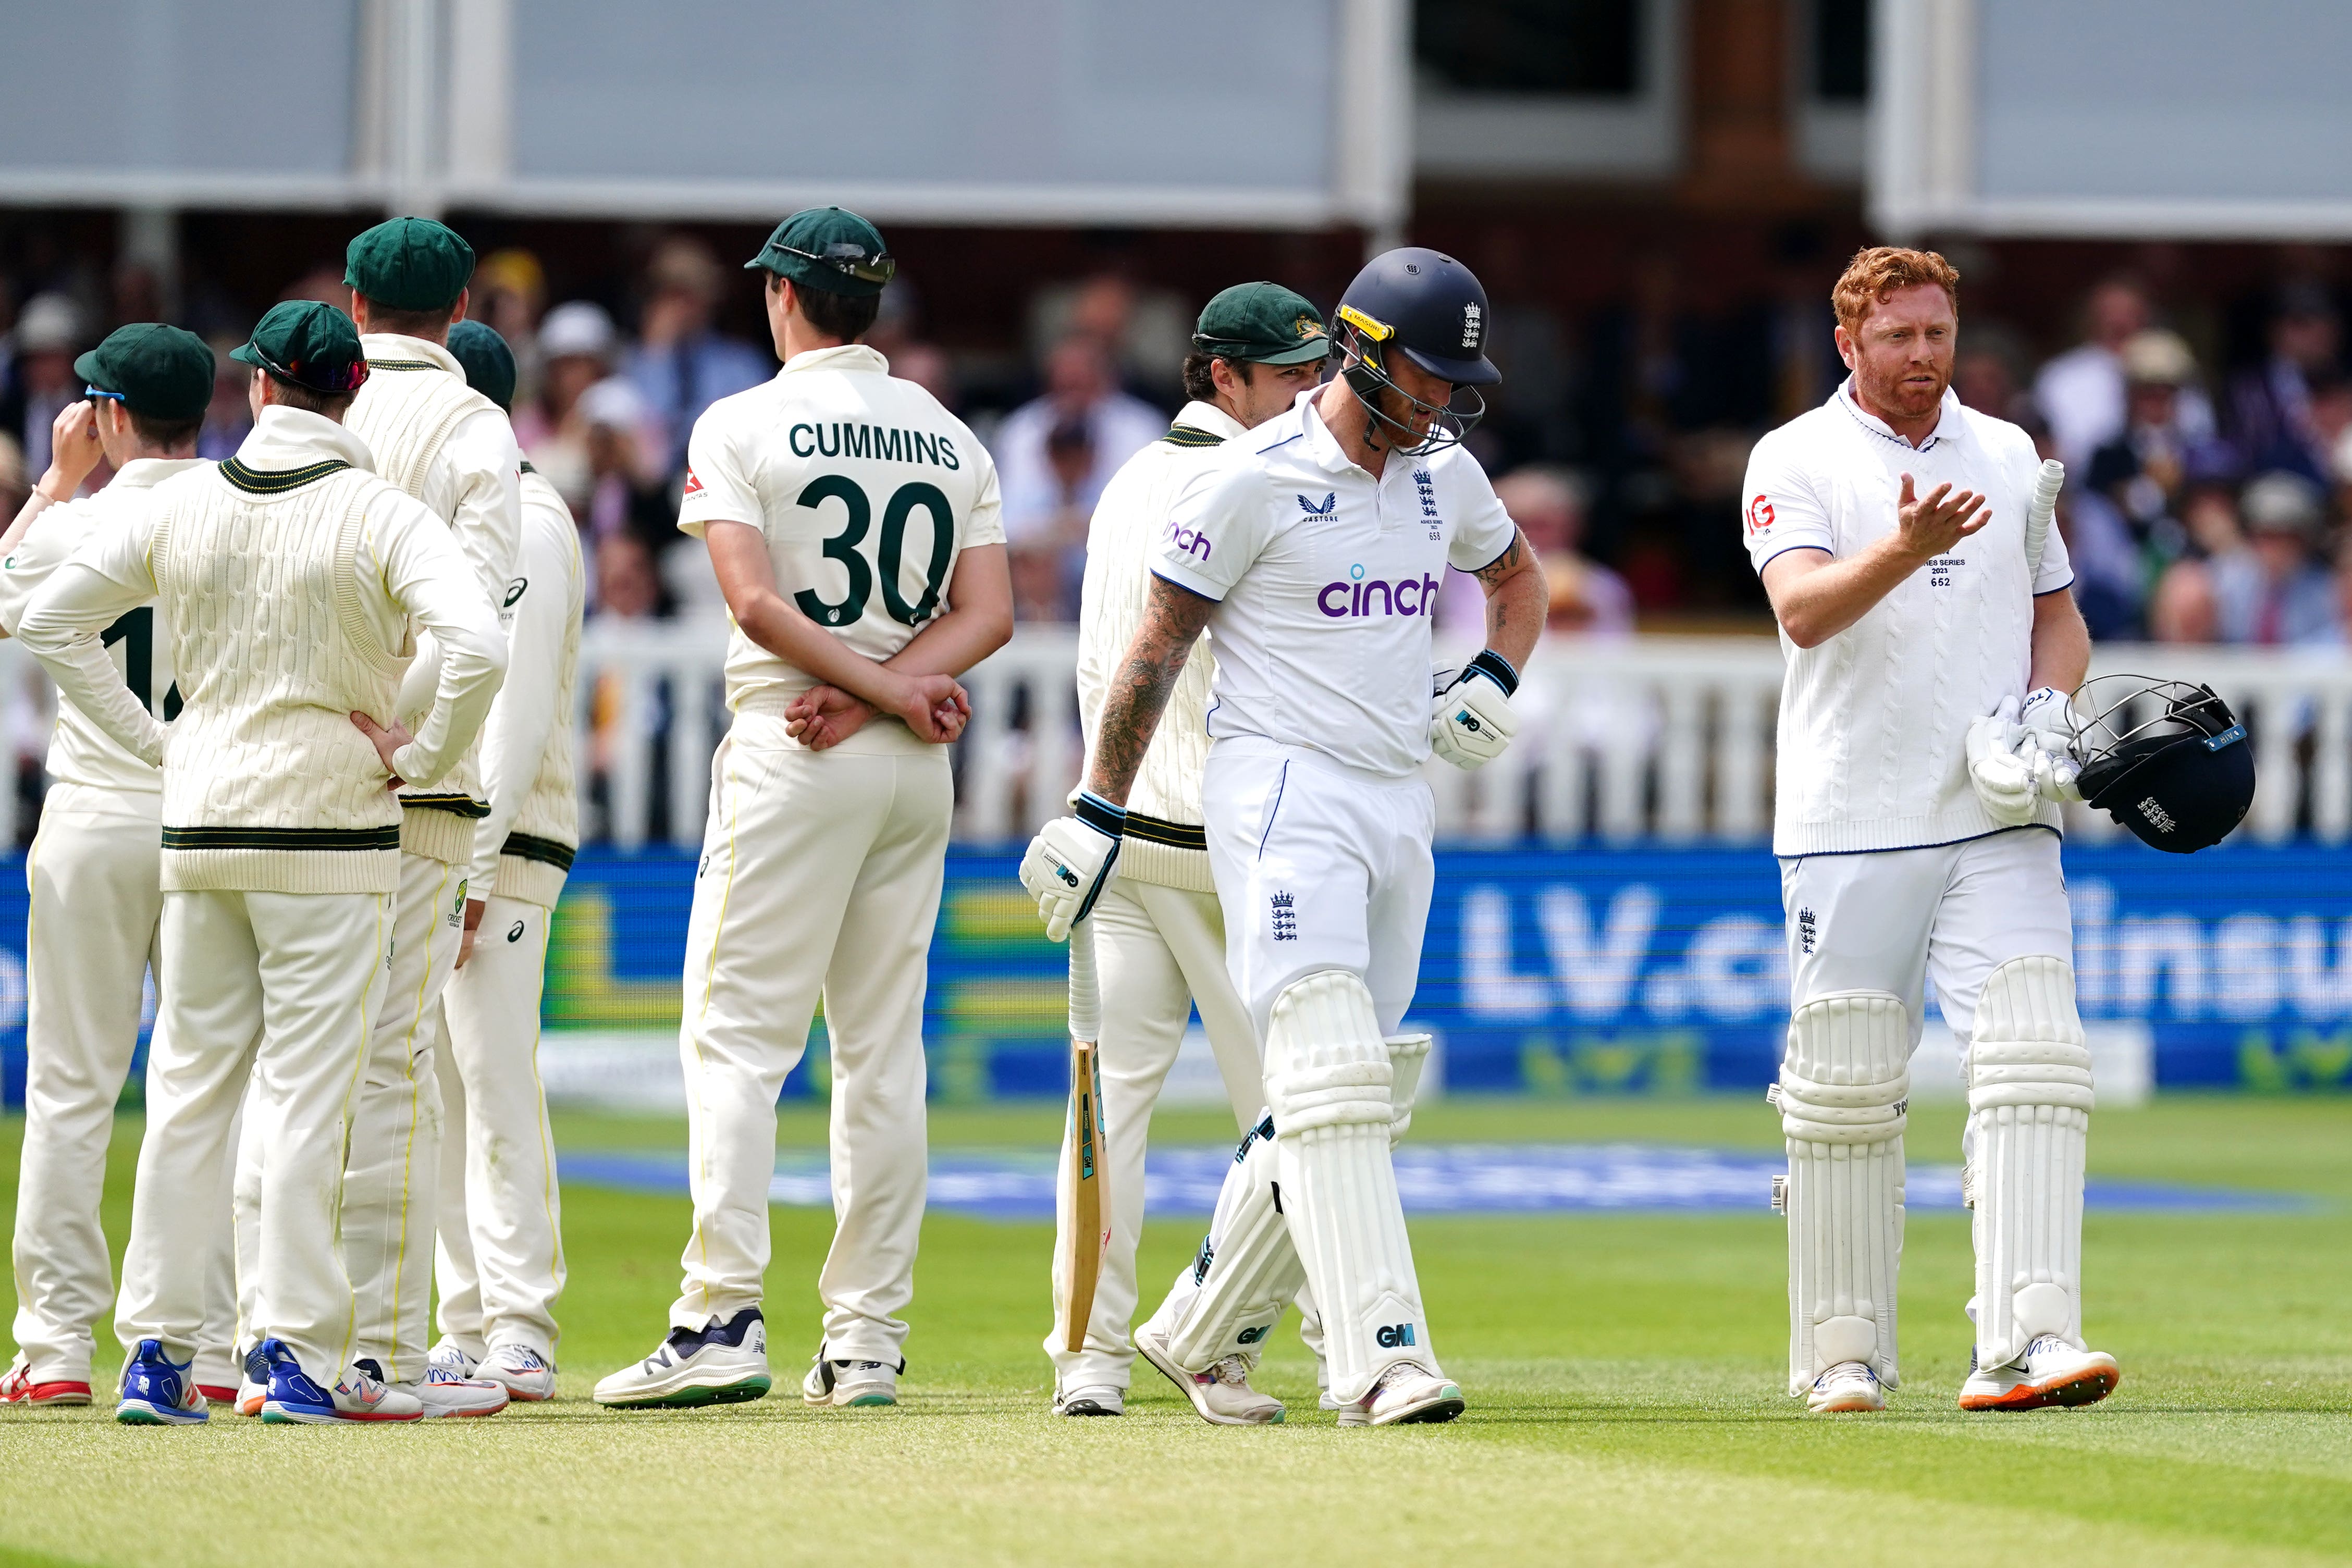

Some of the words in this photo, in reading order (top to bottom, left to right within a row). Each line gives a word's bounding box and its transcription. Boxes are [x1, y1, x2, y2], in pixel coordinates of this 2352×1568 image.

[1354, 314, 1380, 332] MASURI
[789, 423, 959, 471] CUMMINS
[683, 491, 708, 503] ANTAS
[1746, 495, 1775, 537] IG
[1163, 520, 1211, 562] nch
[1429, 532, 1440, 540] 658
[793, 474, 954, 628] 30
[1317, 563, 1439, 617] cinch
[1931, 577, 1950, 587] 652
[101, 606, 186, 722] 1
[2219, 732, 2233, 744] AIR
[1459, 881, 1790, 1021] LV.c
[1893, 1097, 1908, 1116] TO
[1084, 1156, 1092, 1168] GM
[1376, 1323, 1416, 1348] GM
